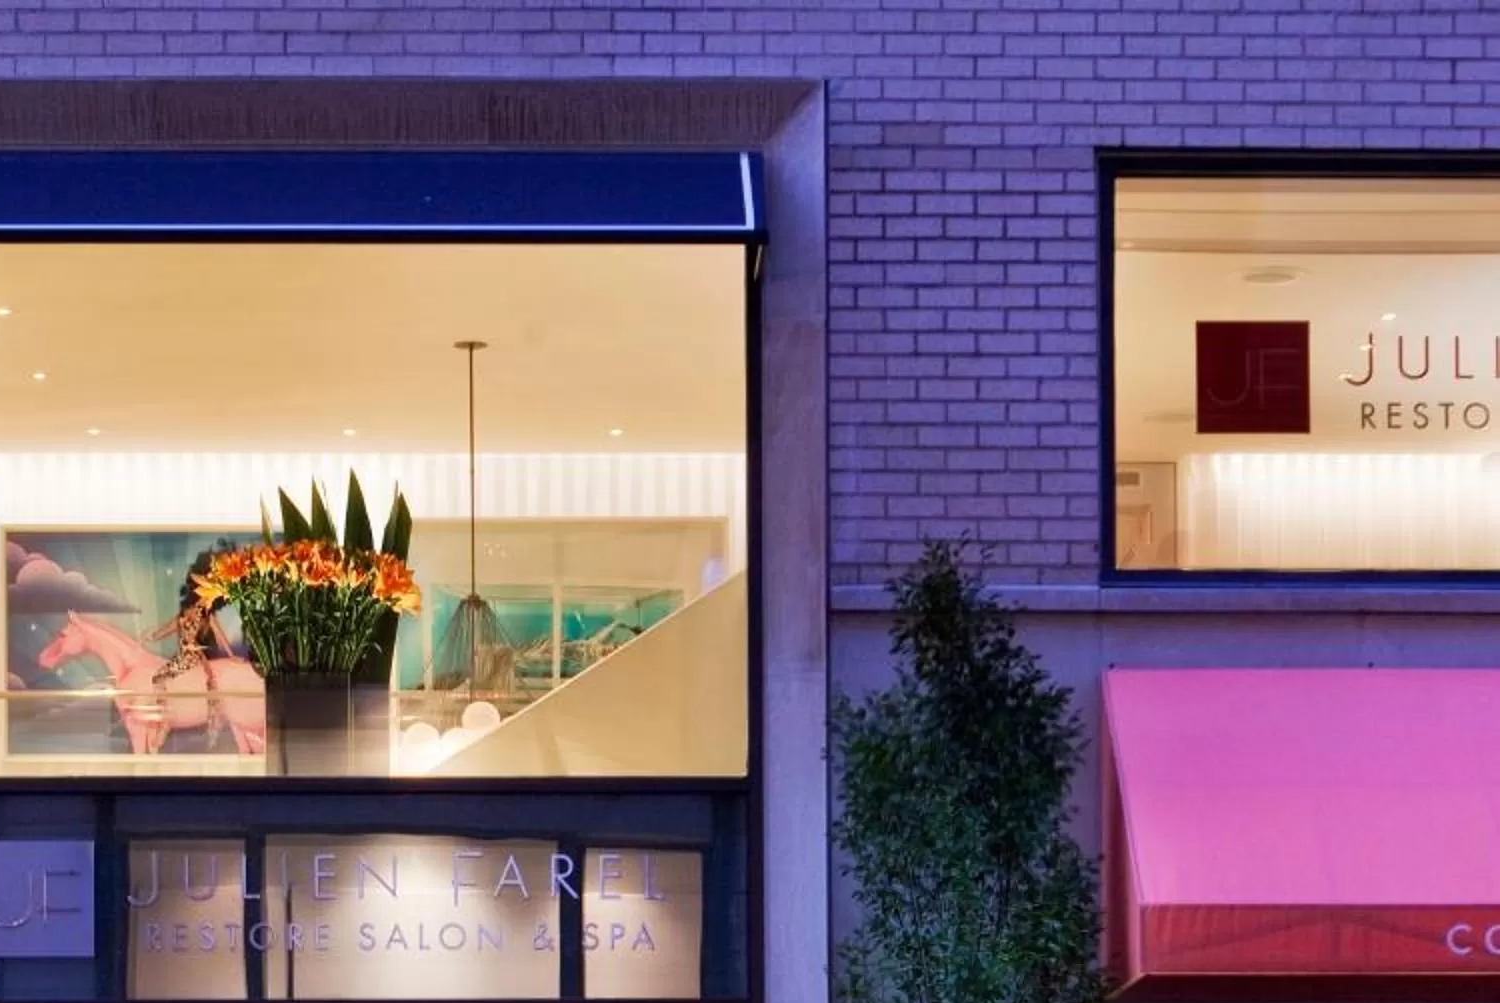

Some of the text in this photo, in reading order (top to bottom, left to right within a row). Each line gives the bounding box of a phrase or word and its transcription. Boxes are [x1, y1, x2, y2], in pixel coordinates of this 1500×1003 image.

[1360, 401, 1491, 430] RESTO
[126, 850, 665, 908] JULIEN FAREL
[146, 921, 657, 952] RESTORE SALON & SPA
